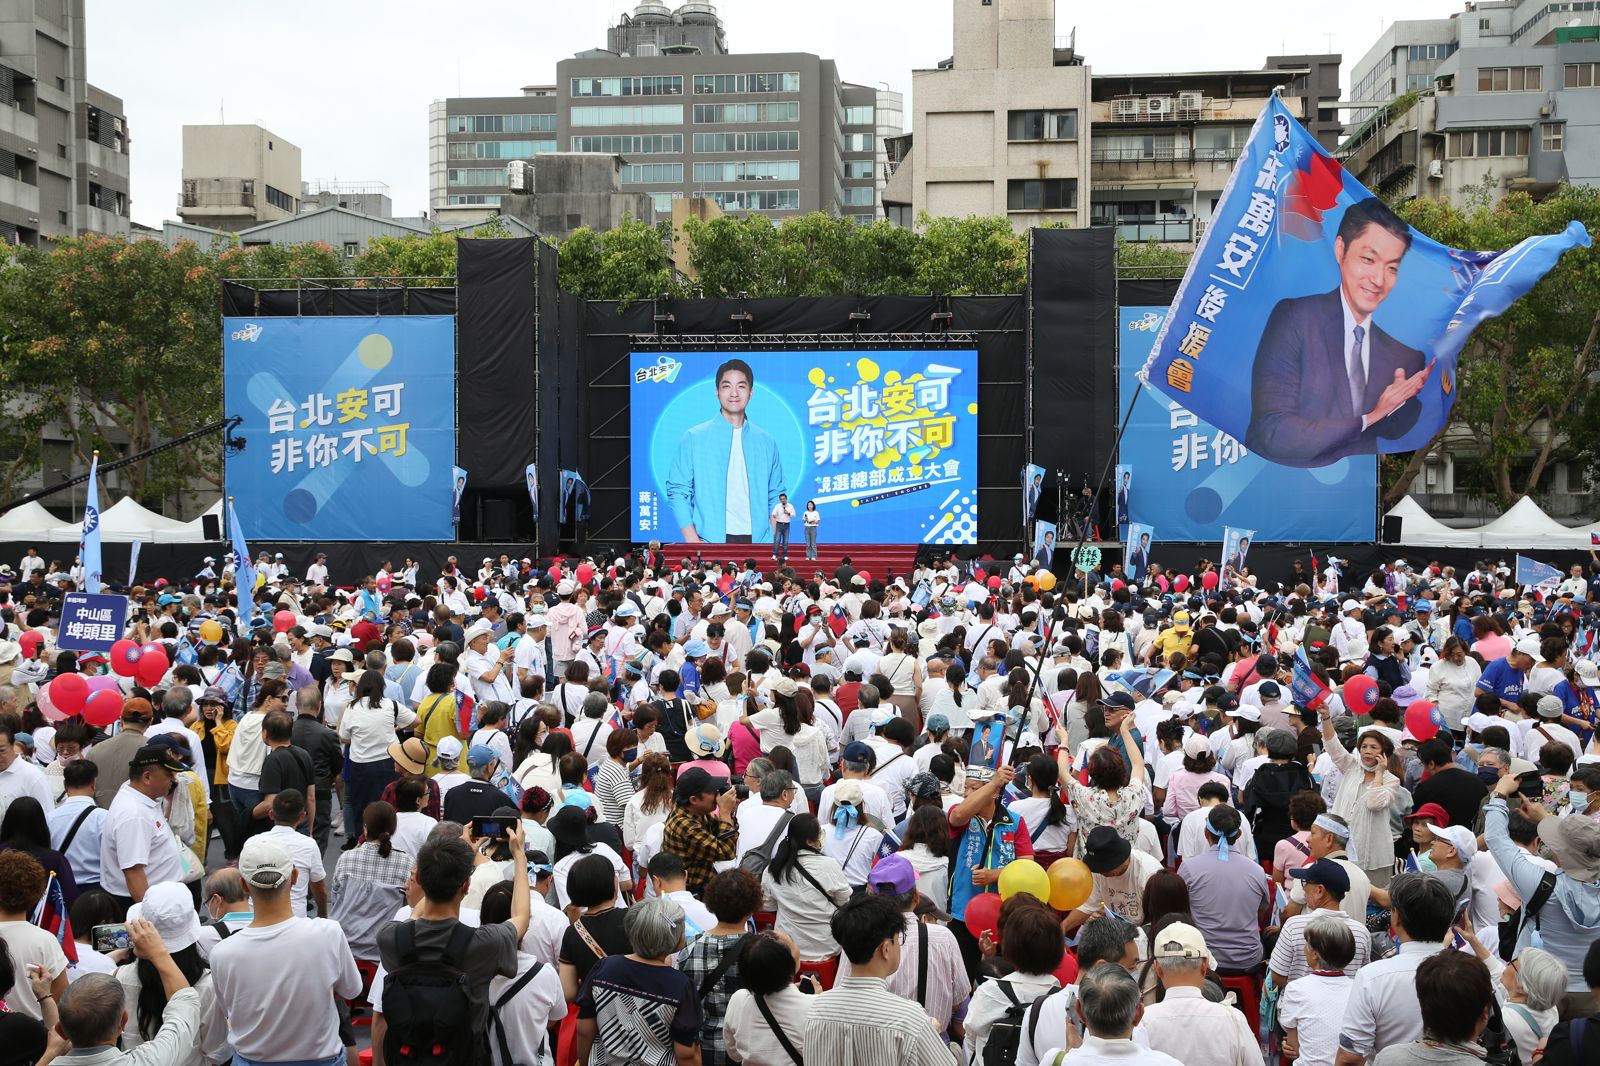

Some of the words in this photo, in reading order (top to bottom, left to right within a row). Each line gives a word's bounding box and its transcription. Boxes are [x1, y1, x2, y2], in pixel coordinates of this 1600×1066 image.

[1166, 284, 1229, 393] 後援會
[636, 363, 675, 382] 台北安可
[268, 383, 404, 434] 台北安可
[808, 378, 952, 426] 台北安可
[271, 423, 410, 474] 非你不可
[814, 414, 957, 465] 非你不可
[639, 491, 651, 531] 蔣萬安
[859, 493, 890, 504] TAIPEI
[894, 483, 929, 496] ENCORE
[66, 621, 117, 641] 埤頭里
[76, 607, 113, 622] 中山區
